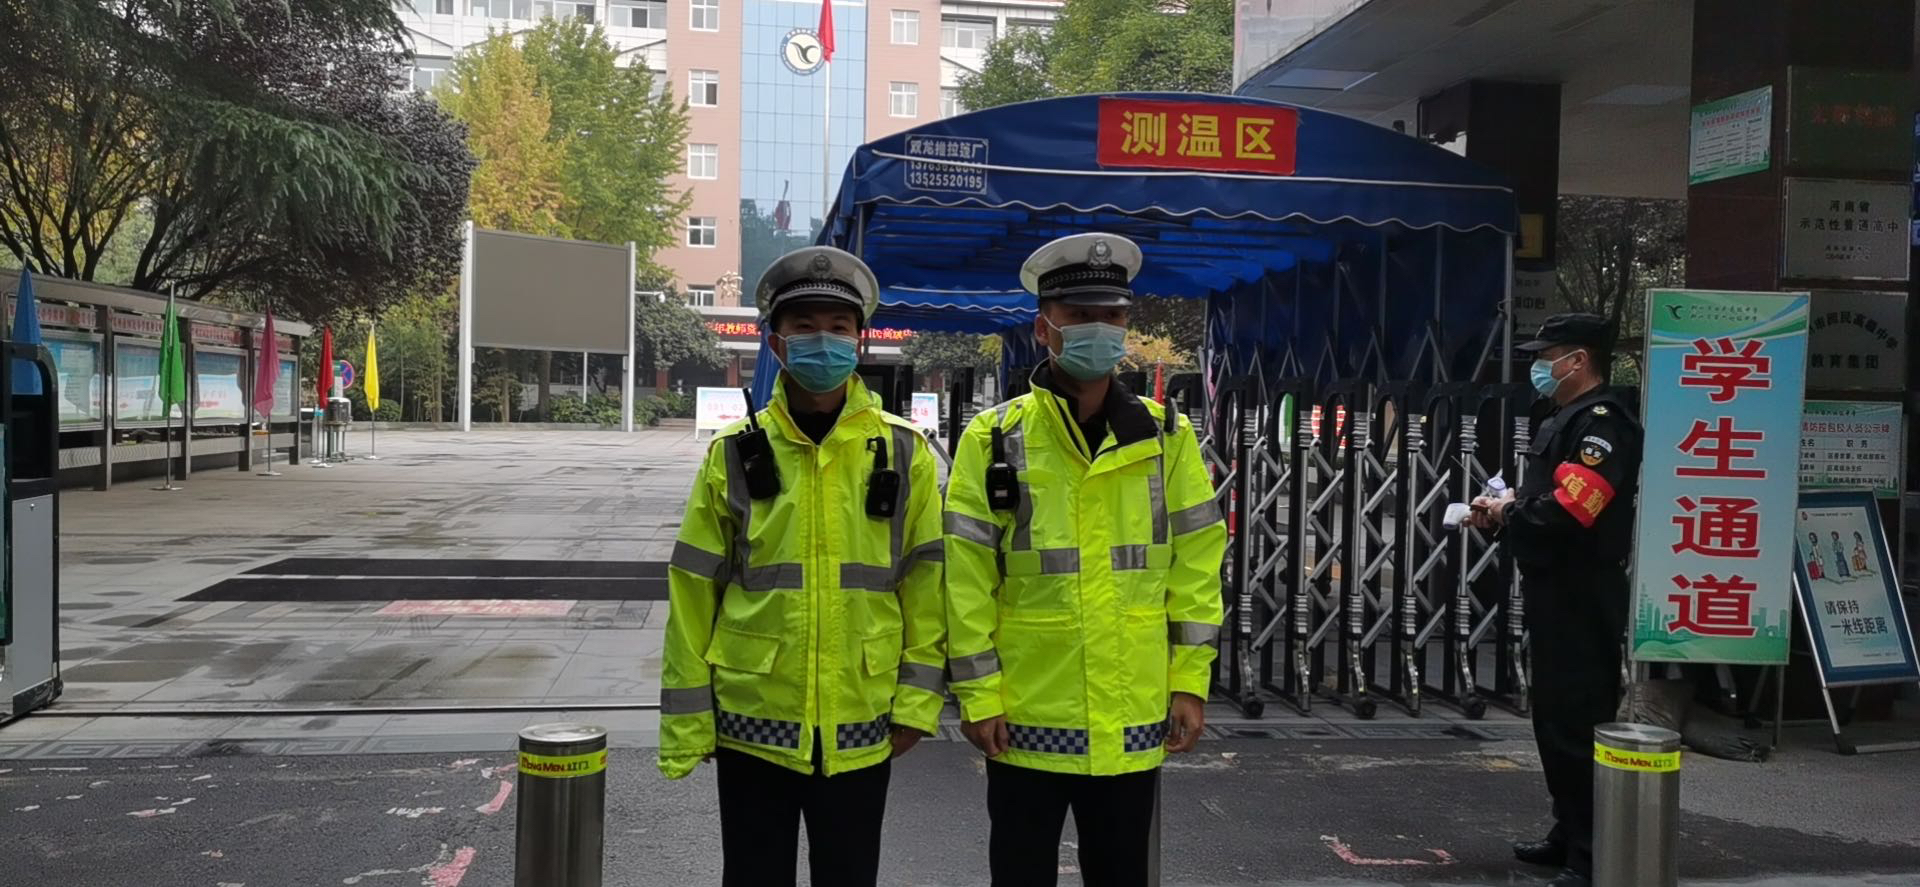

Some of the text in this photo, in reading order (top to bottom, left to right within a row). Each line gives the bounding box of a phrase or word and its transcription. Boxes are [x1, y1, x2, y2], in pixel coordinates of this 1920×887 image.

[1120, 110, 1277, 161] 测温区
[910, 172, 982, 188] 13525520195
[1829, 200, 1870, 213] 河南省
[1799, 217, 1898, 232] 示范性普通高中
[1811, 353, 1878, 369] 教育集团
[1561, 472, 1605, 518] 值勤
[1667, 337, 1772, 638] 学生通道
[1824, 600, 1860, 615] 请保持
[1830, 616, 1888, 635] 一米线距离
